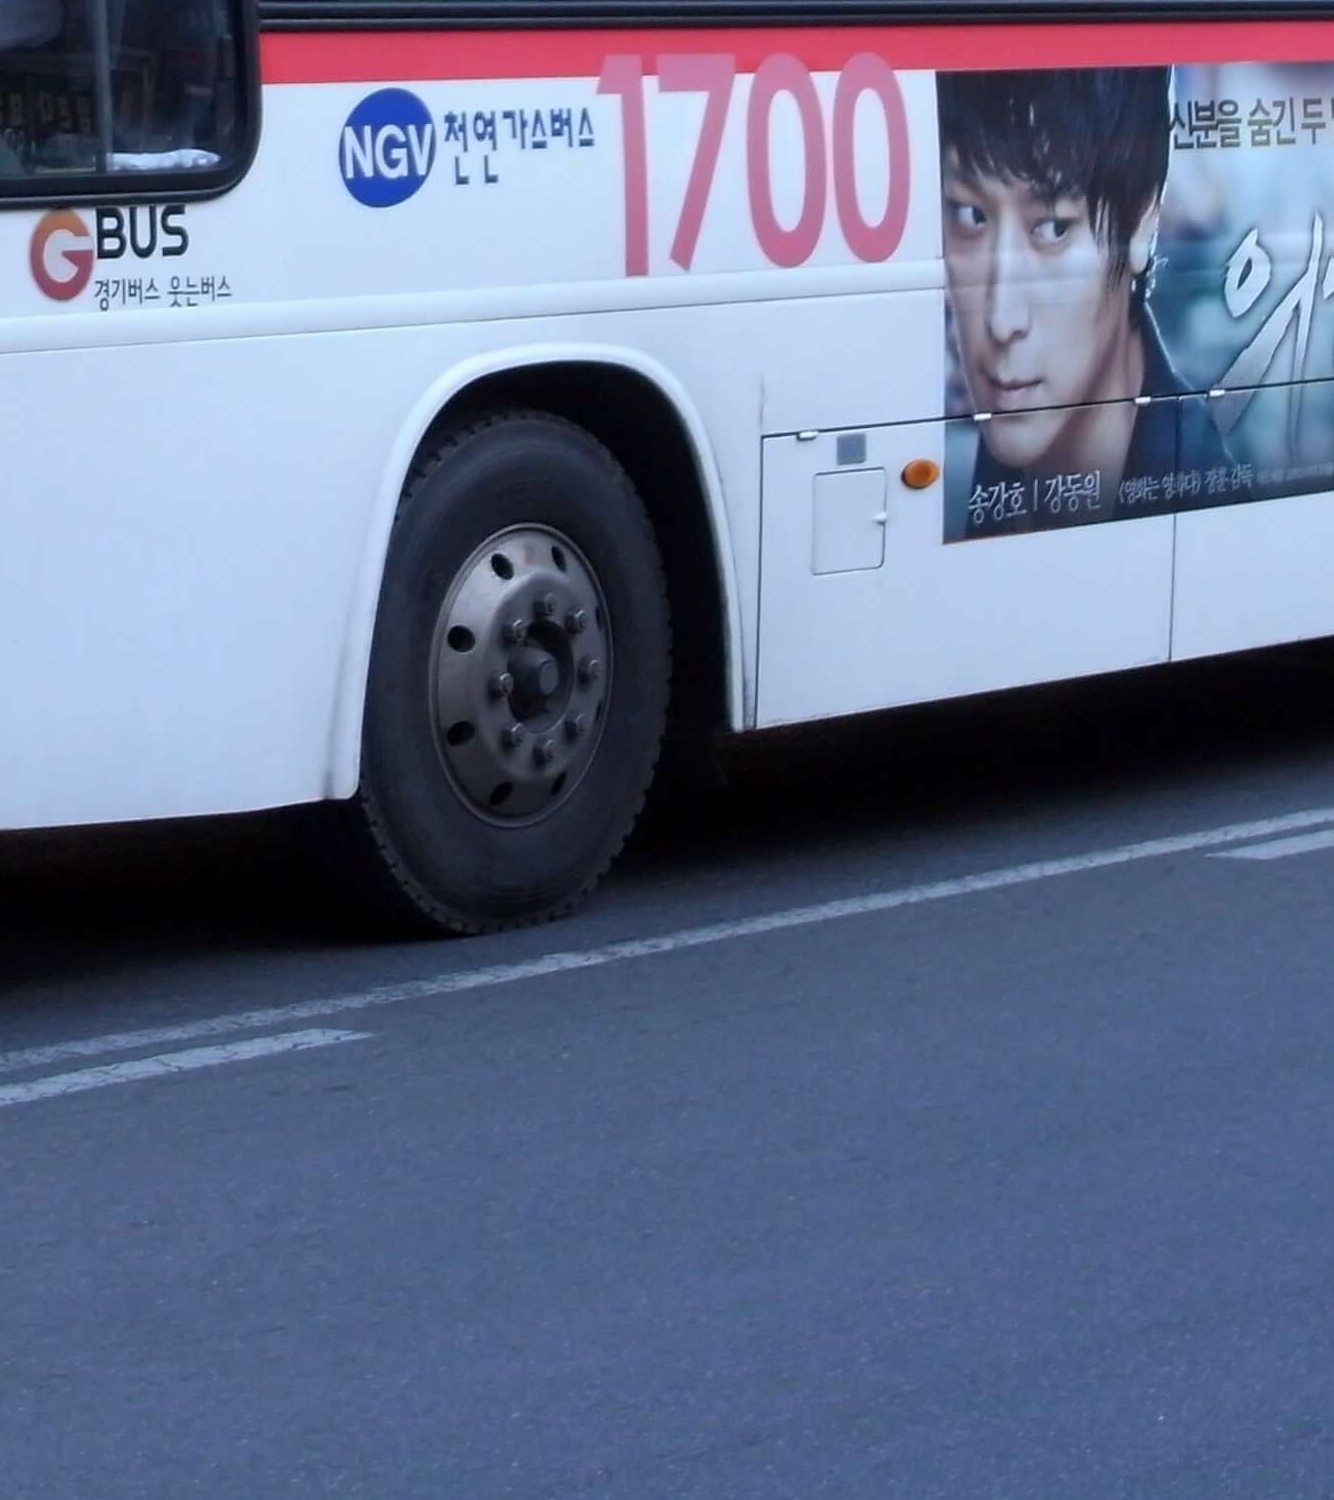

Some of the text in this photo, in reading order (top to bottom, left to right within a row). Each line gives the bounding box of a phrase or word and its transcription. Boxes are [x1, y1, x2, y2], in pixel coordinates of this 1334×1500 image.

[343, 120, 433, 180] NGV
[443, 106, 596, 186] 천연가스버스
[1167, 98, 1242, 150] 신분을
[1247, 96, 1297, 147] 숨긴
[1301, 96, 1327, 145] 두
[596, 52, 911, 277] 1700
[94, 275, 233, 312] 경기버스 웃는버스
[968, 480, 1028, 525] 송강호
[1043, 469, 1102, 514] 강동원
